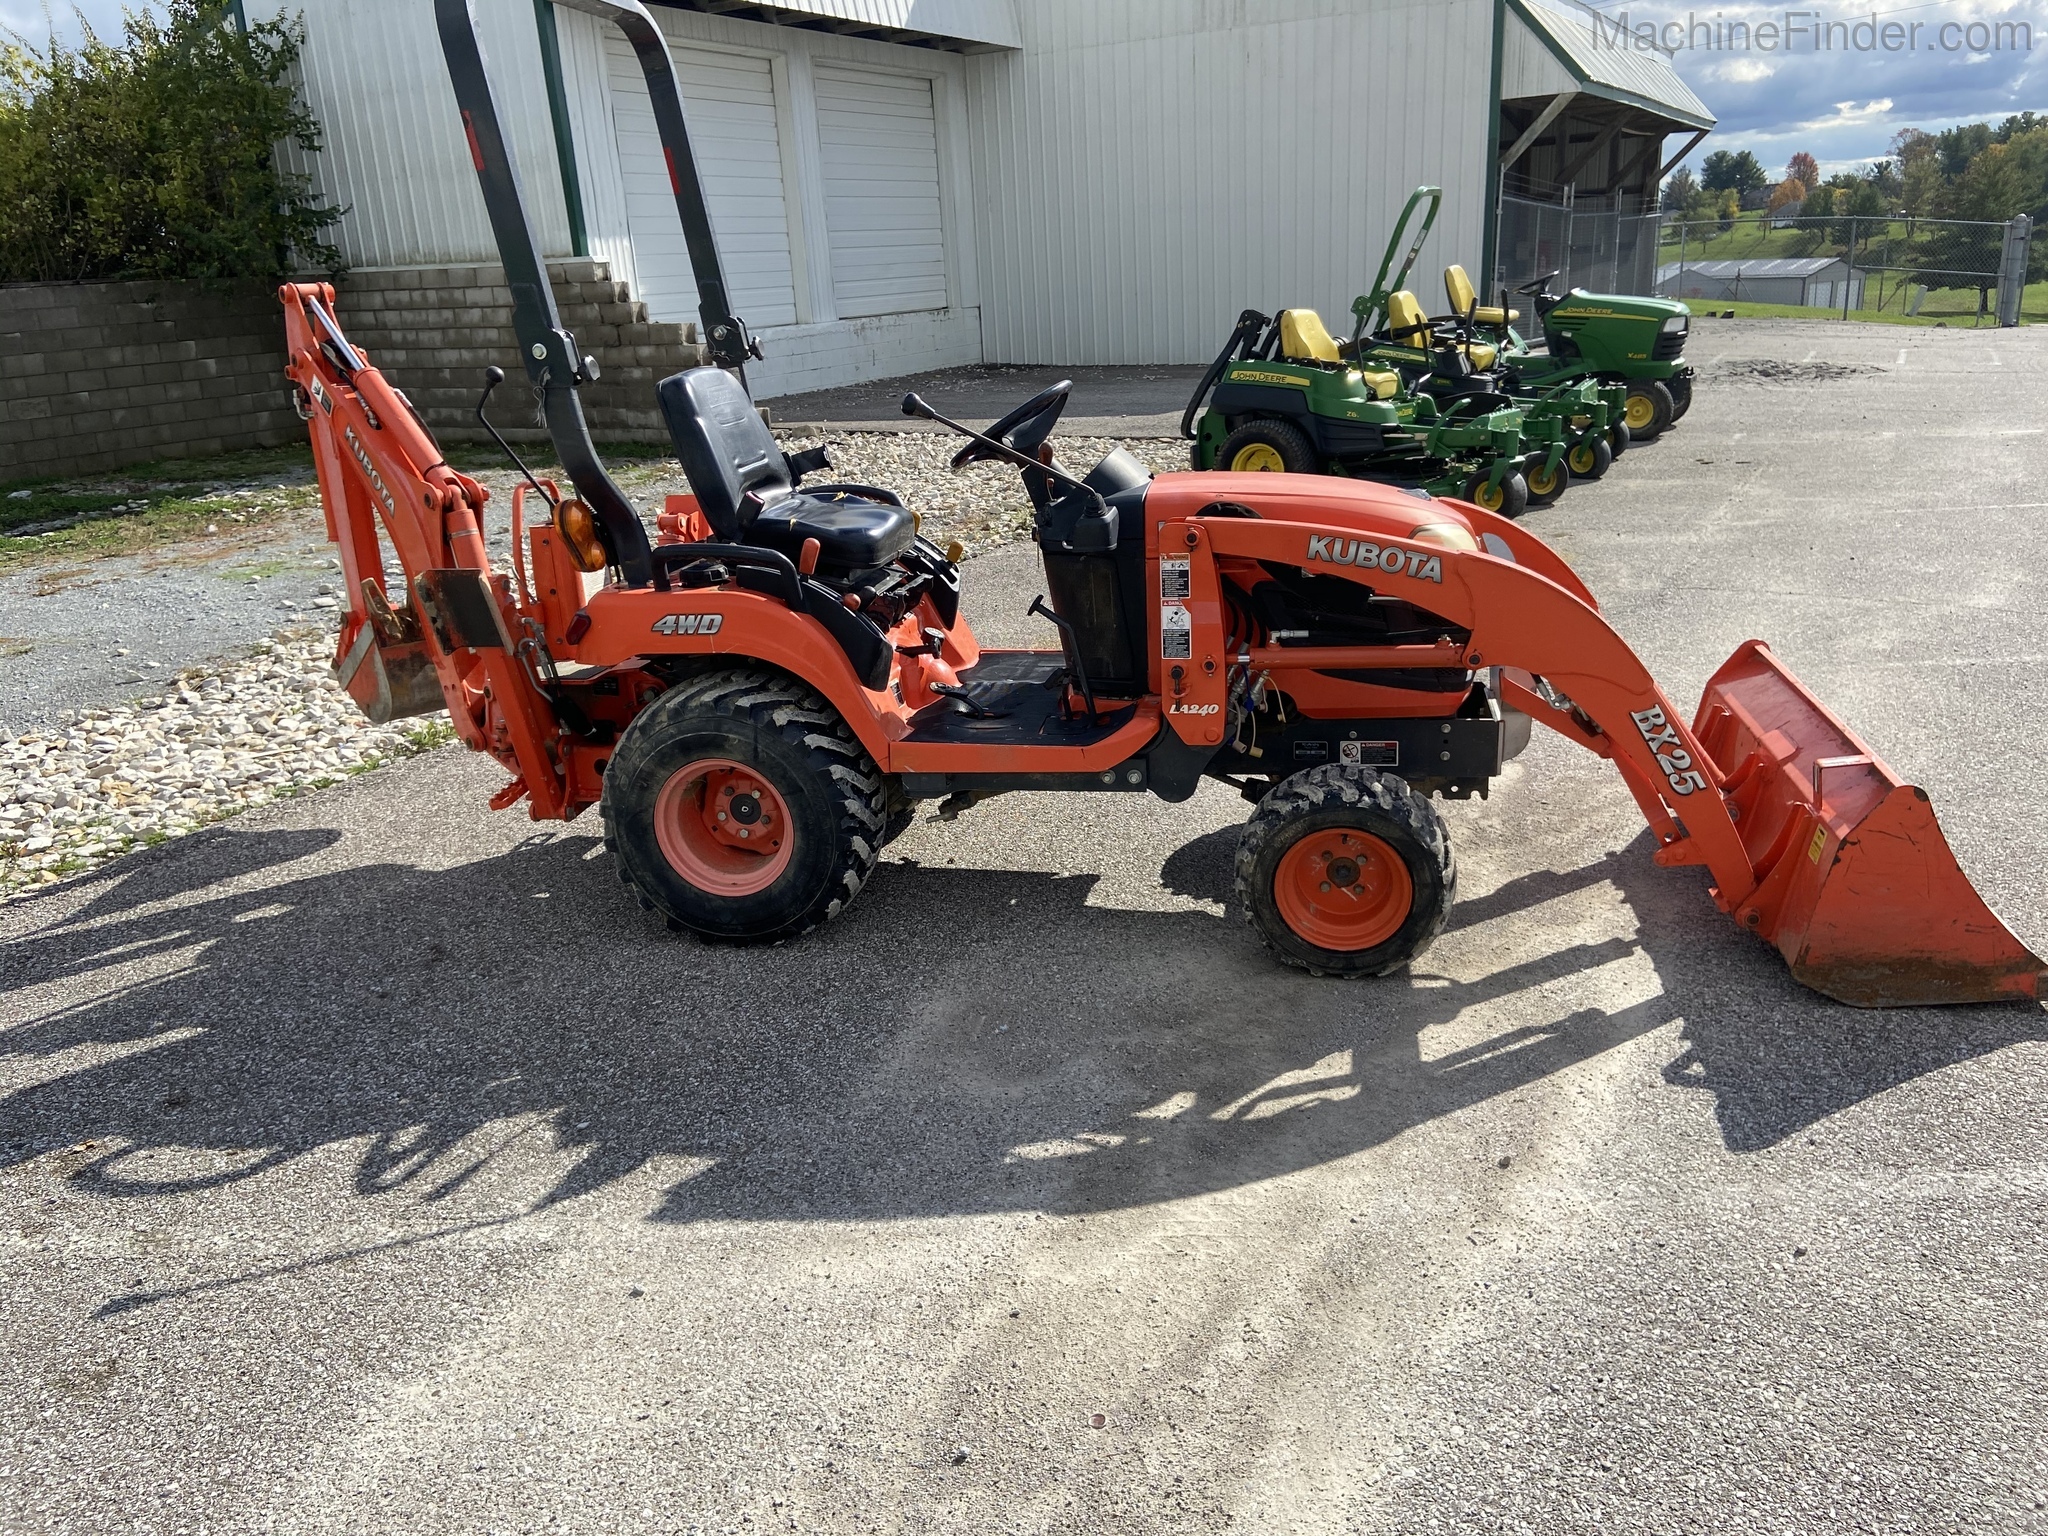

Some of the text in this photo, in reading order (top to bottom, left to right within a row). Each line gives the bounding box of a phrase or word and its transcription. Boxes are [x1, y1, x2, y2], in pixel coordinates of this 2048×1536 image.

[1564, 306, 1613, 315] JOHN DEERE
[1233, 371, 1288, 383] JOHN DEERE
[344, 423, 396, 520] KUBOTA
[1307, 534, 1442, 584] KUBOTA
[651, 613, 724, 636] 4WD
[1168, 703, 1220, 717] LA240
[1629, 703, 1708, 797] BX25
